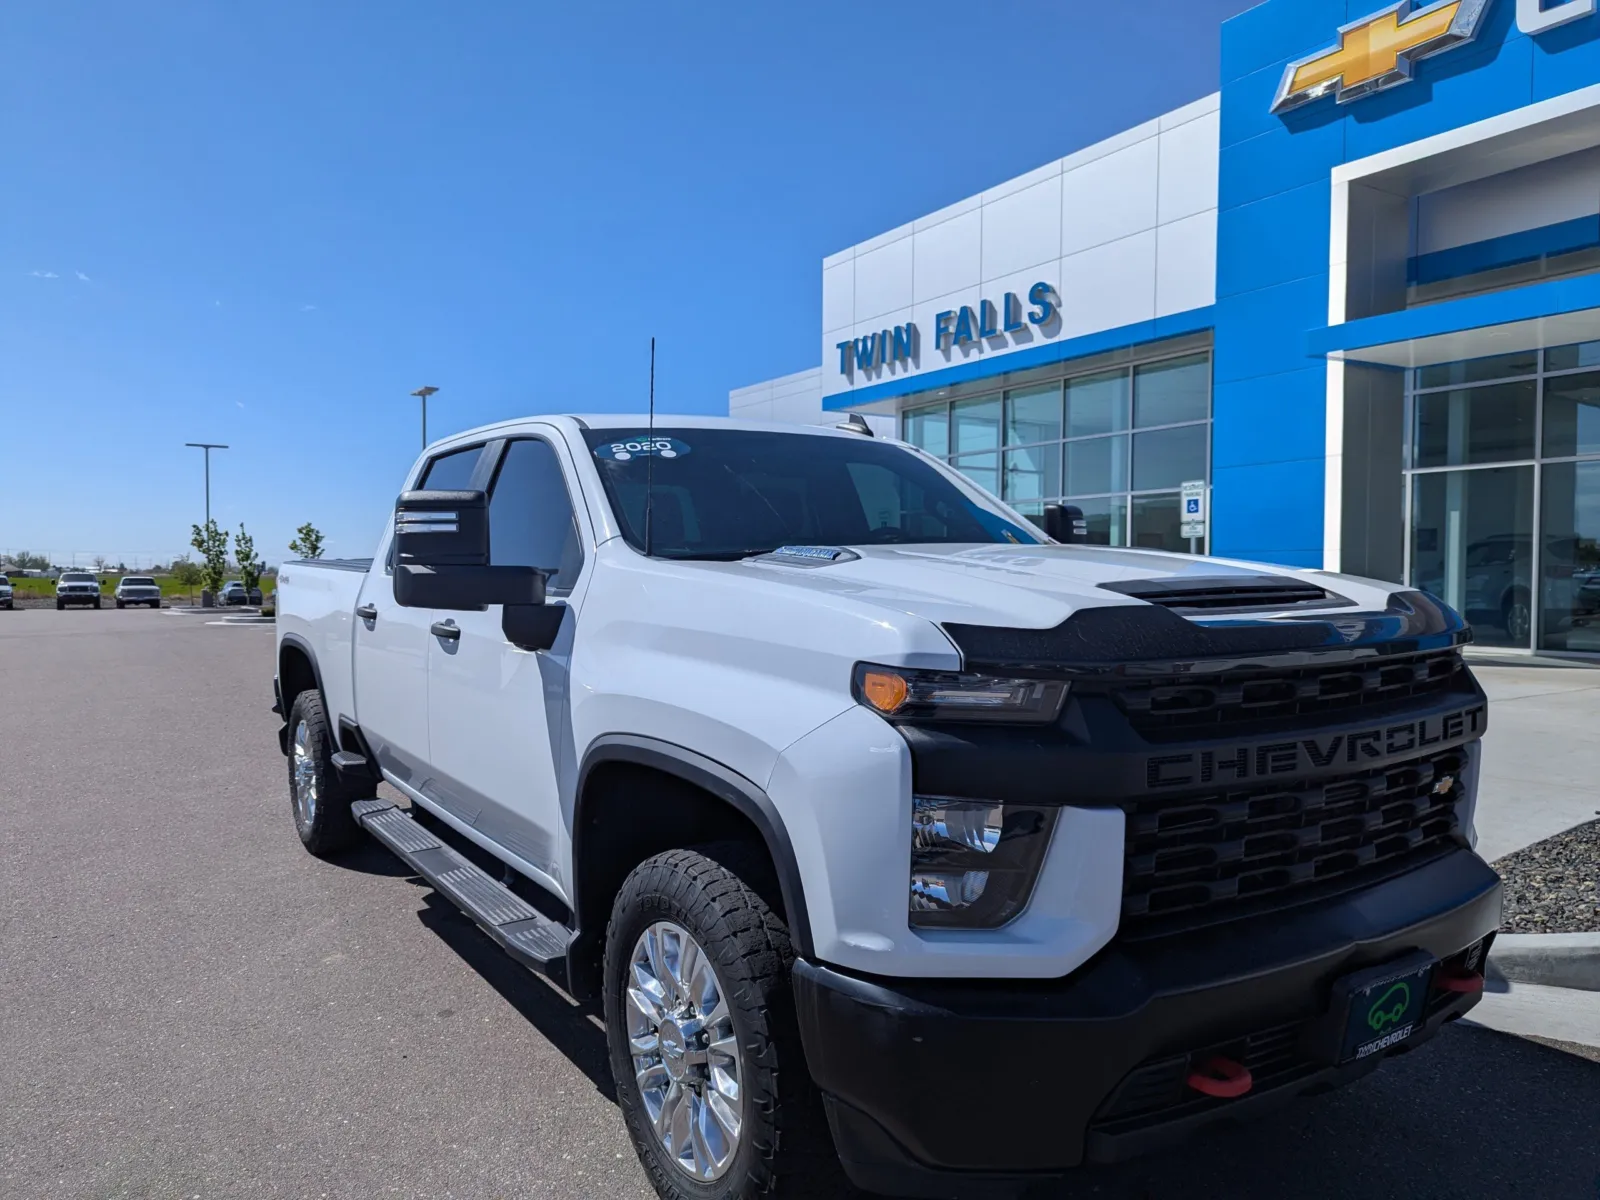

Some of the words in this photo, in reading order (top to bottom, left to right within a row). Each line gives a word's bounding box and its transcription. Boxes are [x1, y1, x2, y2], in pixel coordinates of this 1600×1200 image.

[836, 322, 914, 375] TWIN
[935, 281, 1055, 350] FALLS
[610, 441, 672, 452] 2020
[1146, 705, 1484, 789] CHEVROLET
